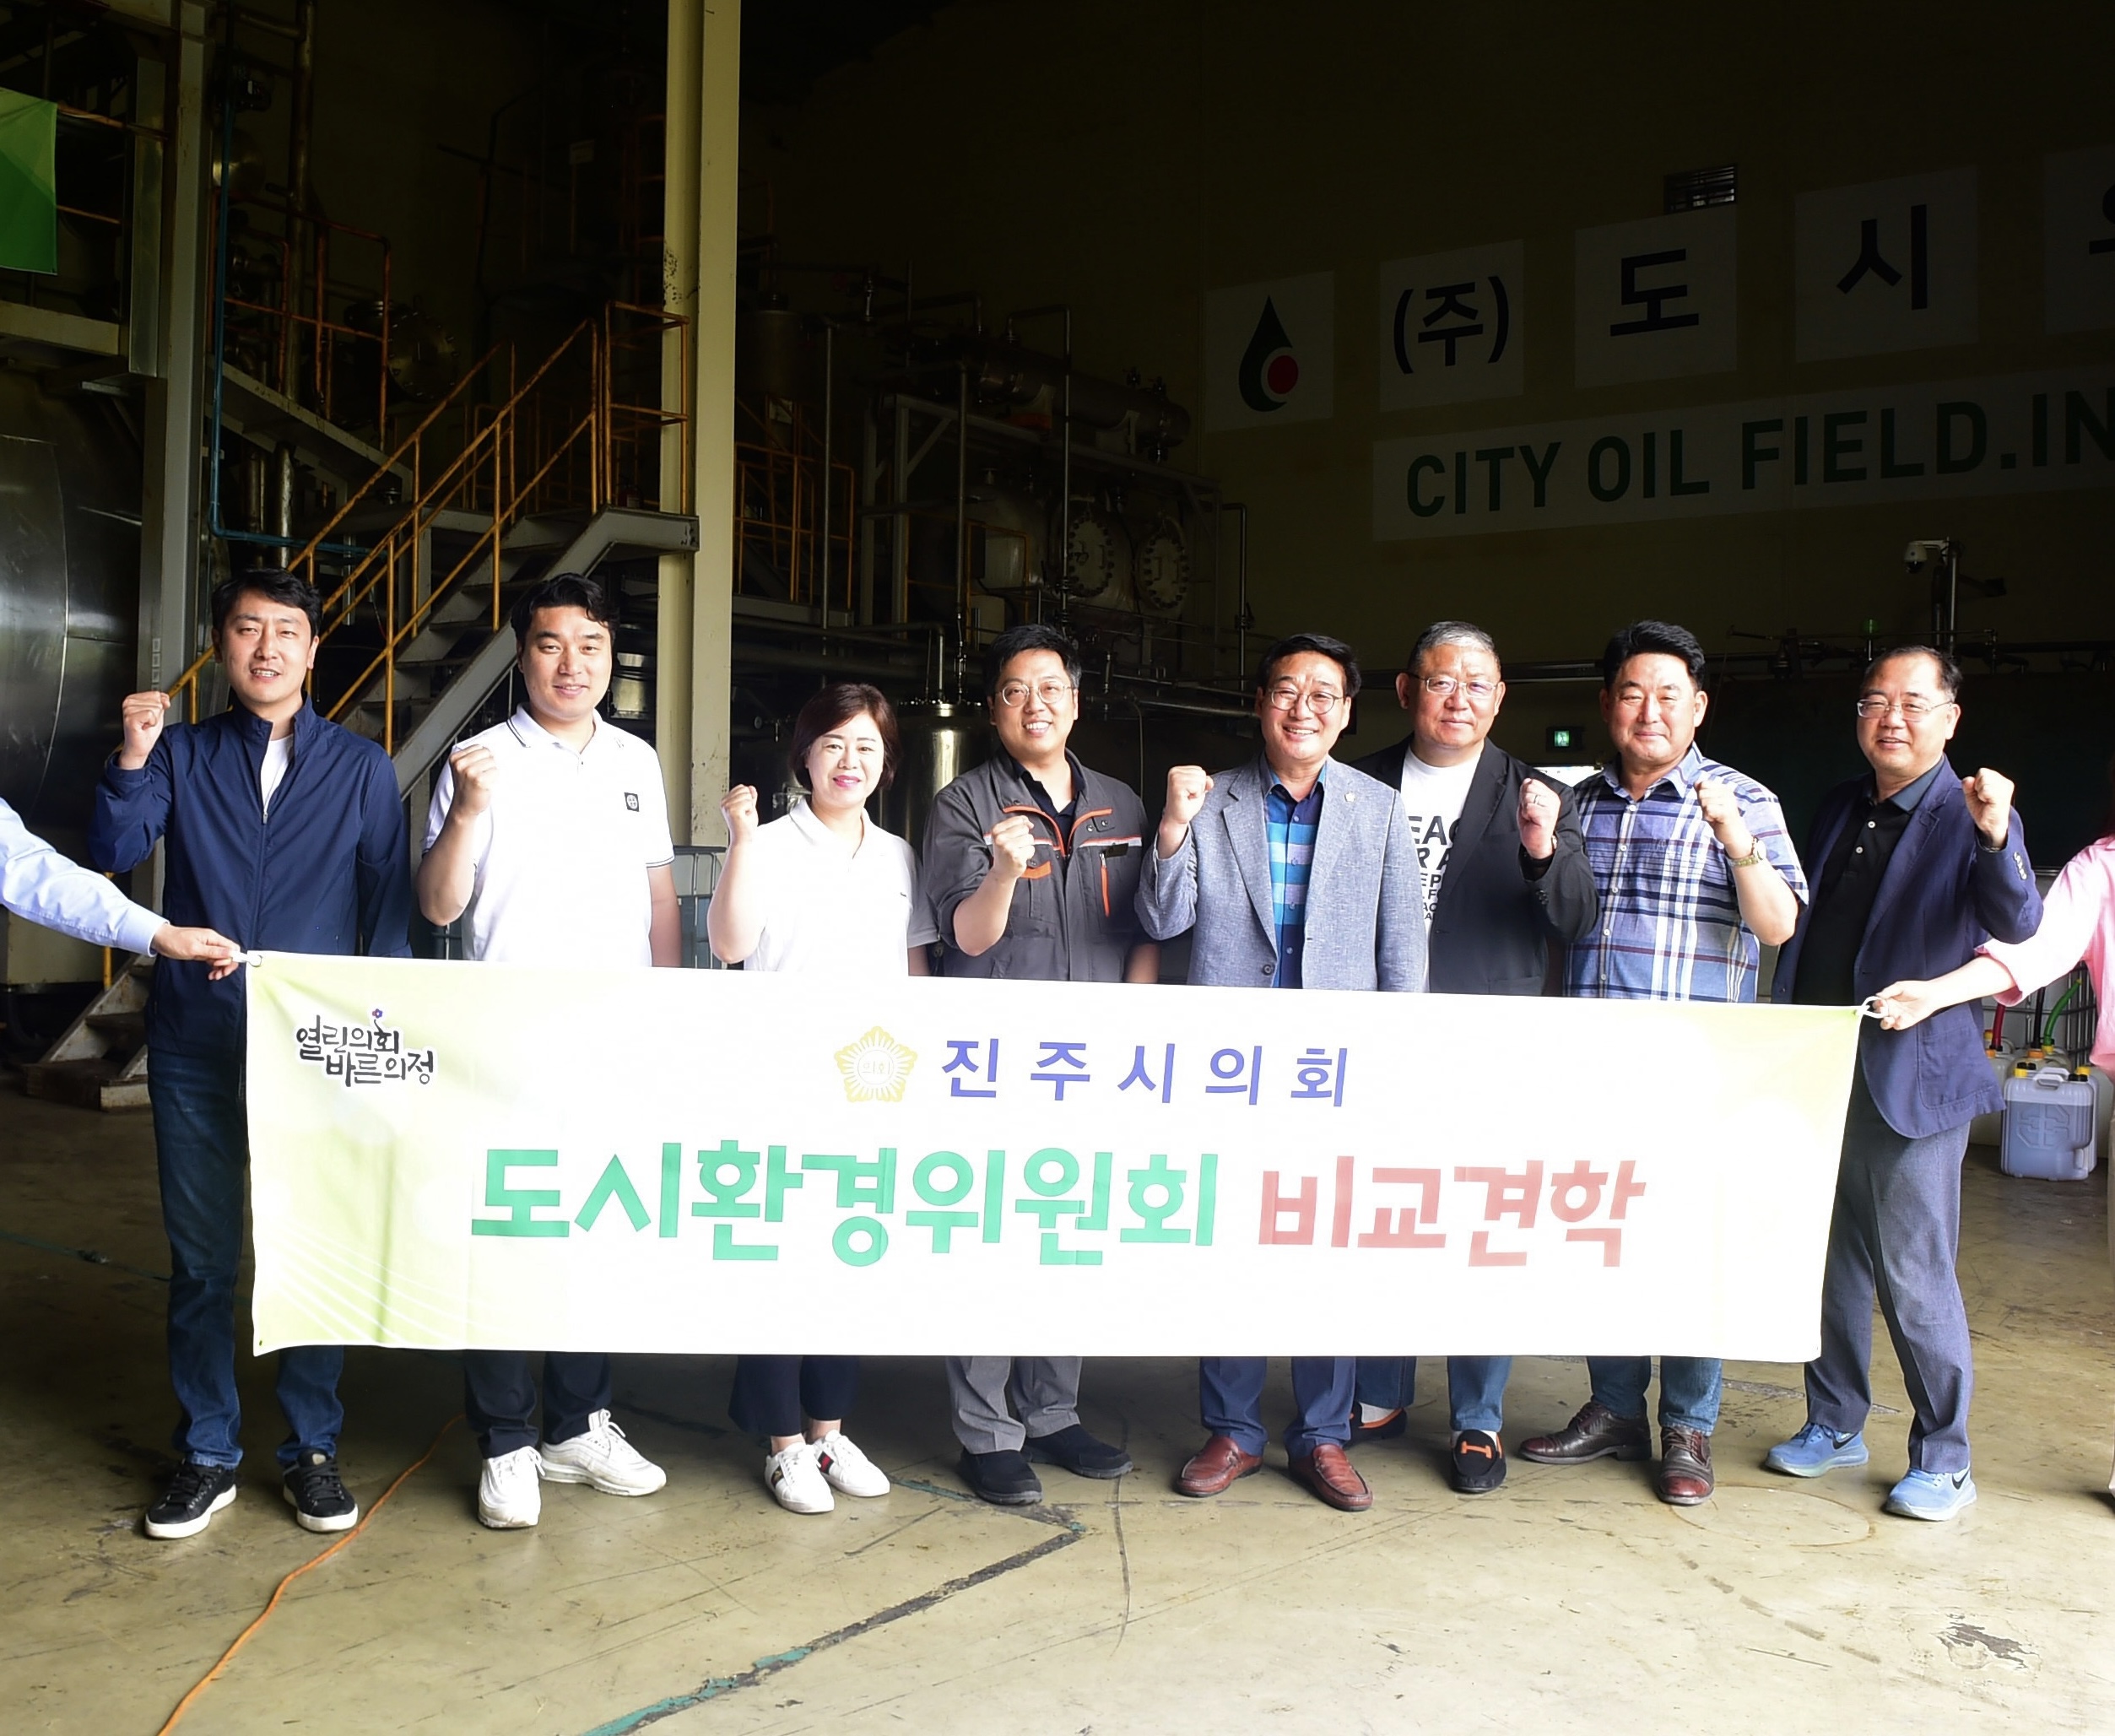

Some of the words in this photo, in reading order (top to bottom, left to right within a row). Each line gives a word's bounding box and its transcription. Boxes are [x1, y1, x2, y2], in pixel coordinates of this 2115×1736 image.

[1407, 442, 1561, 517] CITY
[1588, 429, 1710, 503] OIL
[296, 1014, 400, 1062] 열린의회
[326, 1050, 434, 1087] 바른의정
[941, 1038, 1348, 1107] 진주시의회
[471, 1139, 1219, 1267] 도시환경위원회
[1259, 1155, 1647, 1267] 비교견학
